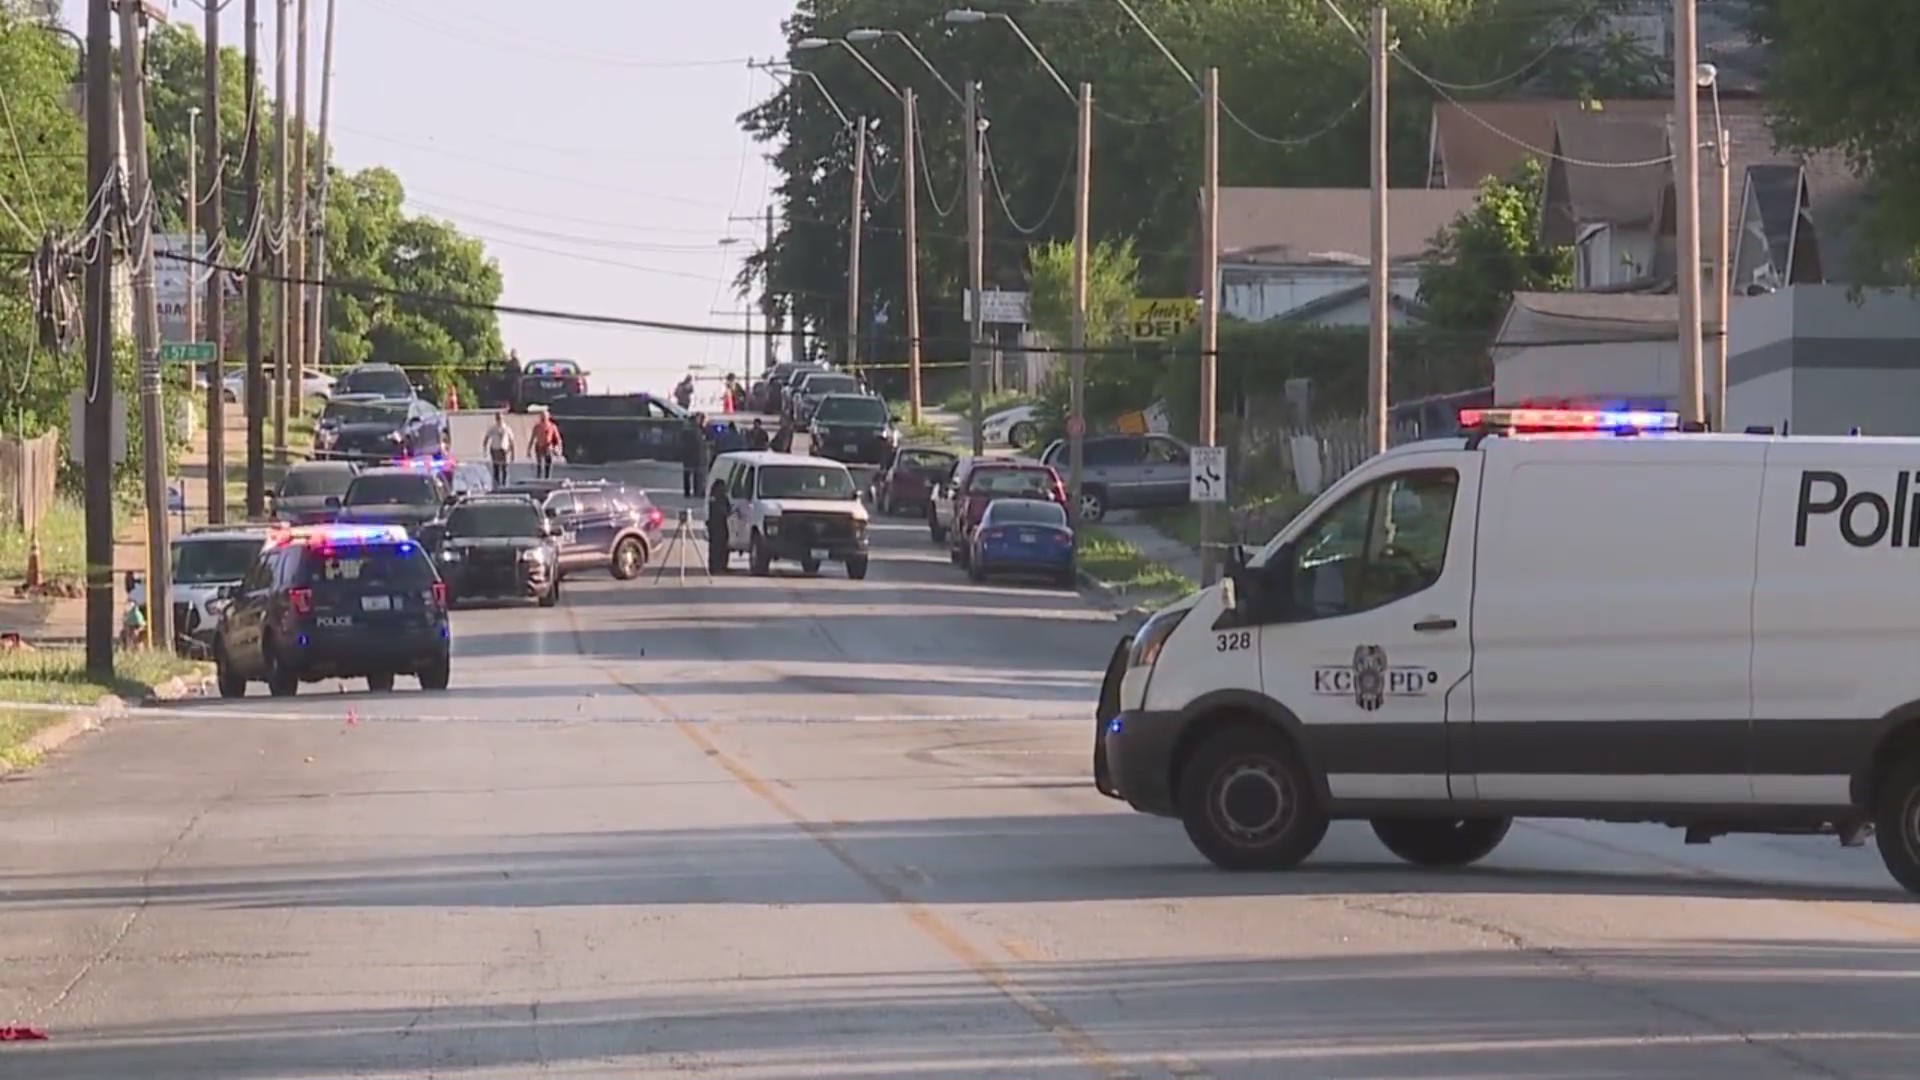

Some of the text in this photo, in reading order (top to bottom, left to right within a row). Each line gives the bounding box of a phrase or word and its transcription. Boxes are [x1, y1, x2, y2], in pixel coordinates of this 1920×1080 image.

[1795, 470, 1920, 547] Poli
[316, 616, 352, 627] POLICE
[1216, 631, 1251, 652] 328
